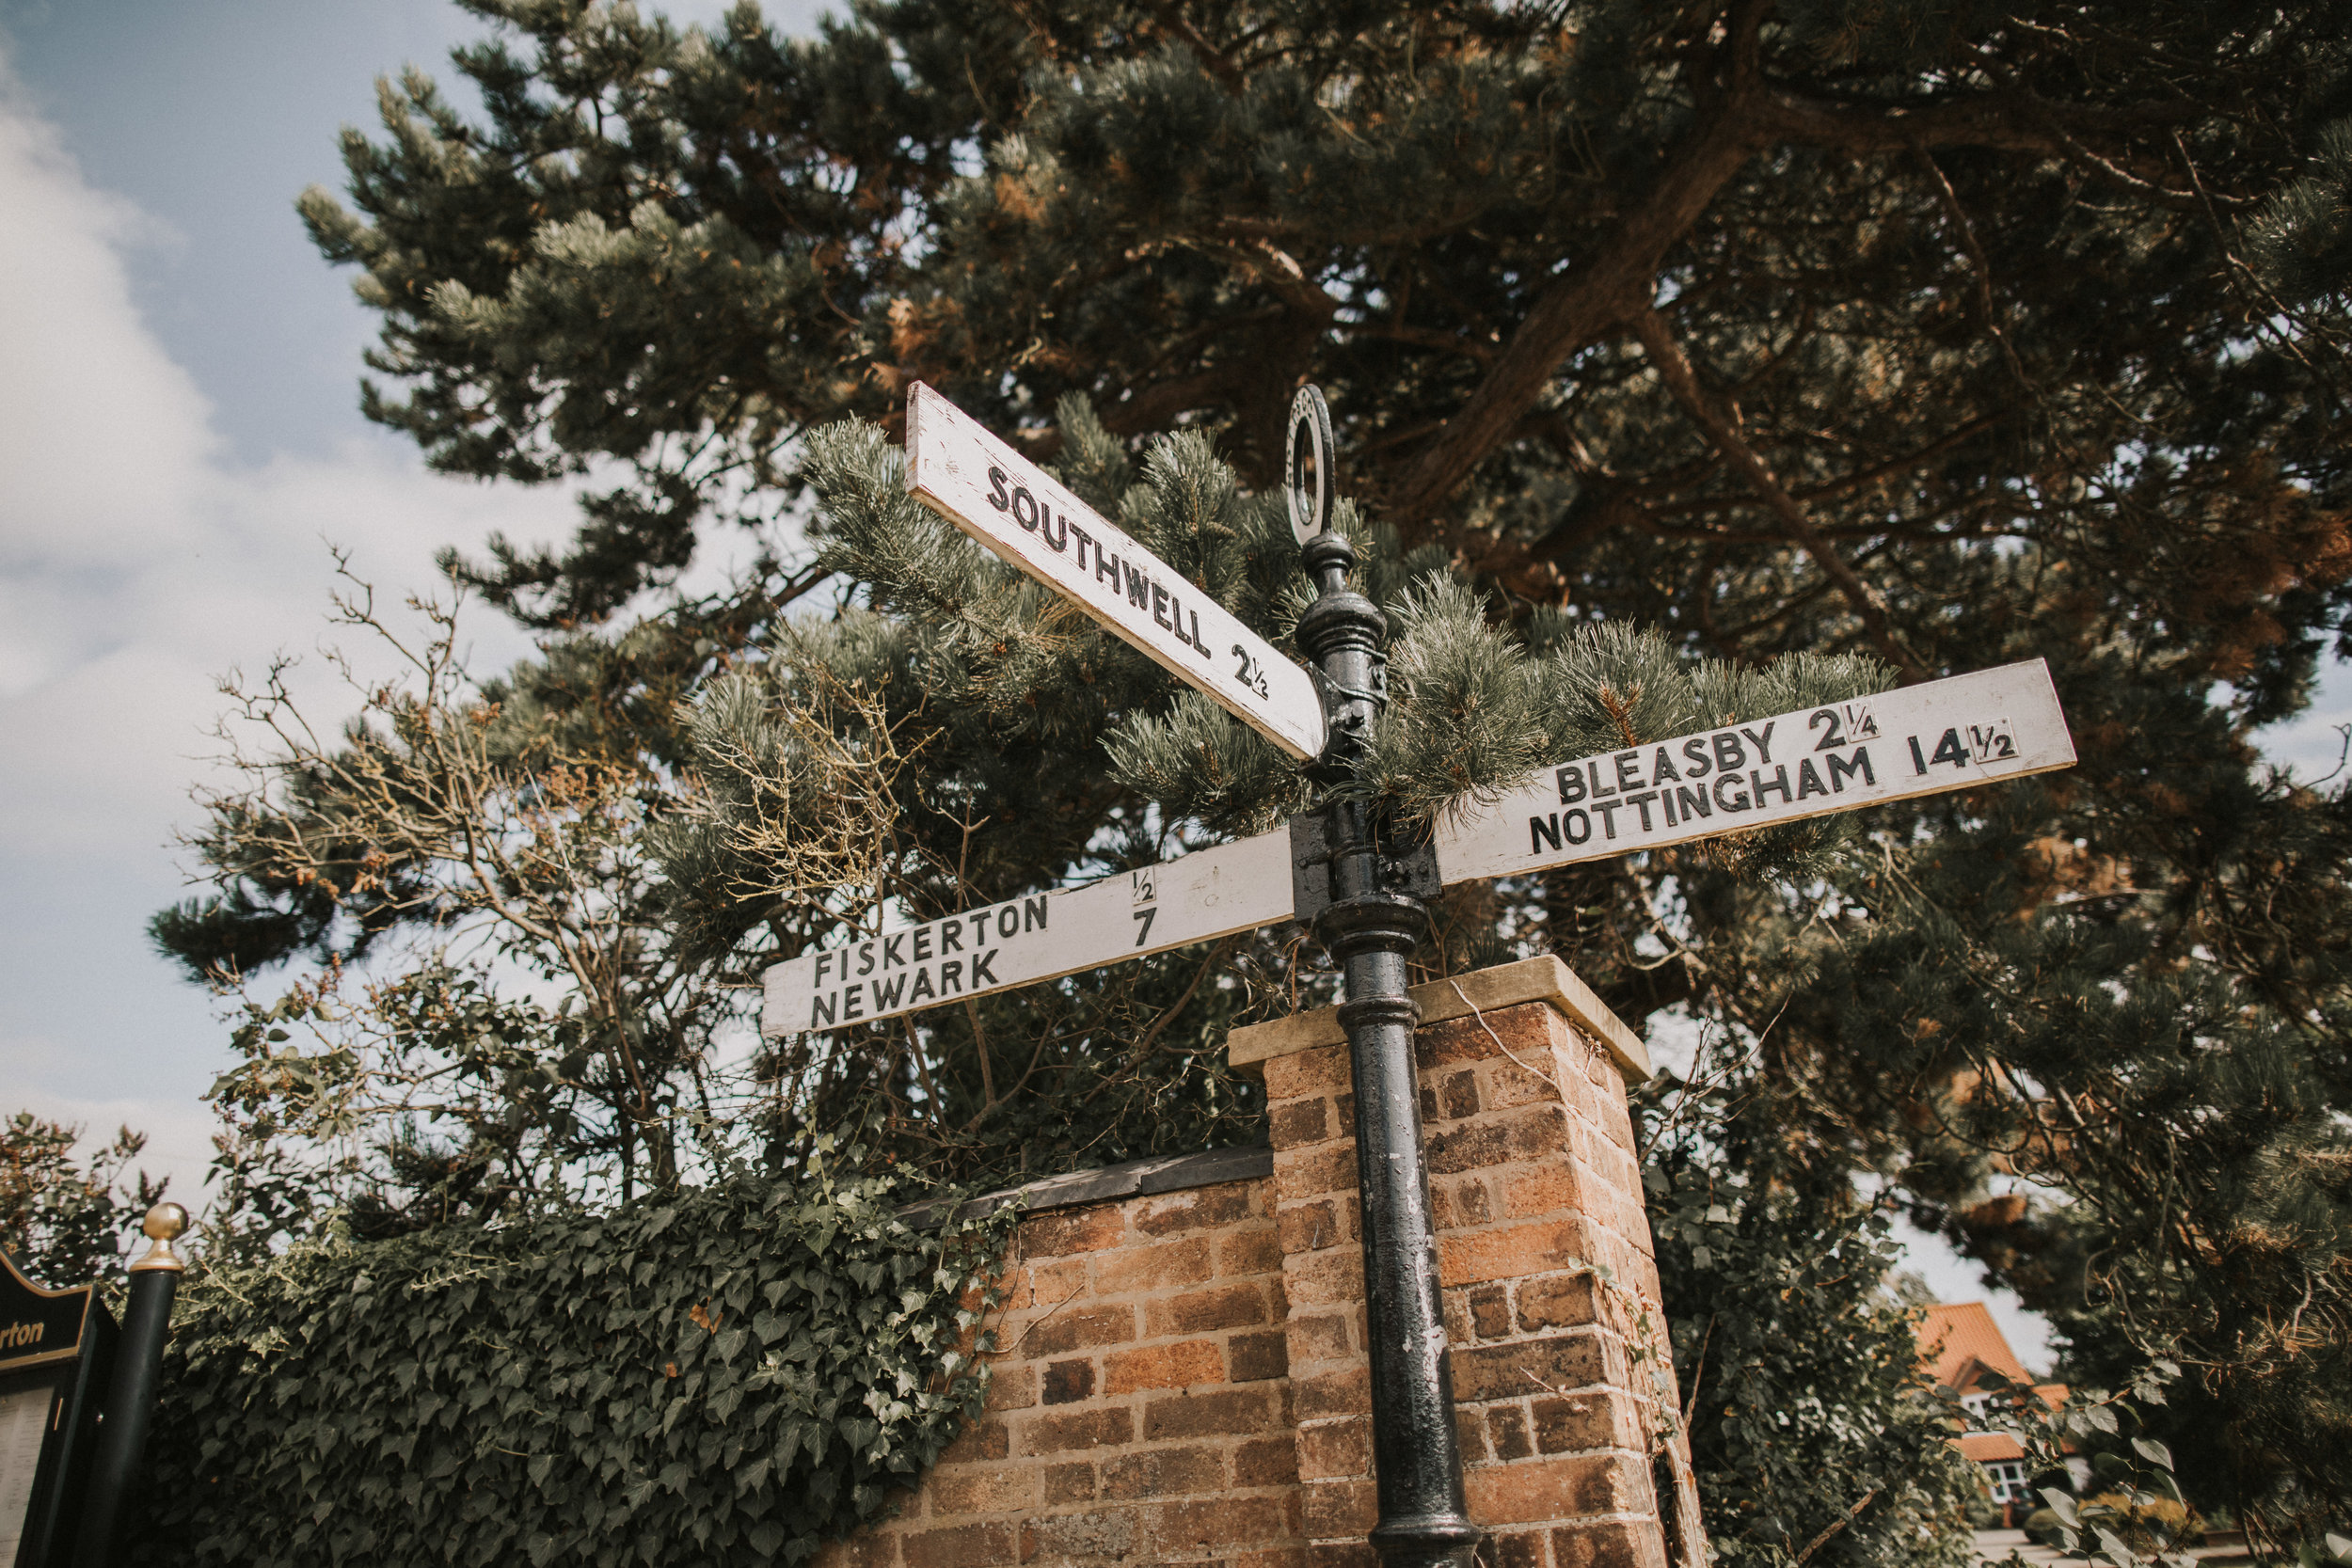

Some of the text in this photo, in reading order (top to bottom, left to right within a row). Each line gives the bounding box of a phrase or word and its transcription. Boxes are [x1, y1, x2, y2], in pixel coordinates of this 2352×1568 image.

[987, 466, 1212, 659] SOUTHWELL
[1529, 746, 1876, 854] NOTTINGHAM
[1556, 721, 1776, 805] BLEASBY
[810, 907, 1158, 1029] NEWARK 7
[814, 895, 1048, 989] FISKERTON
